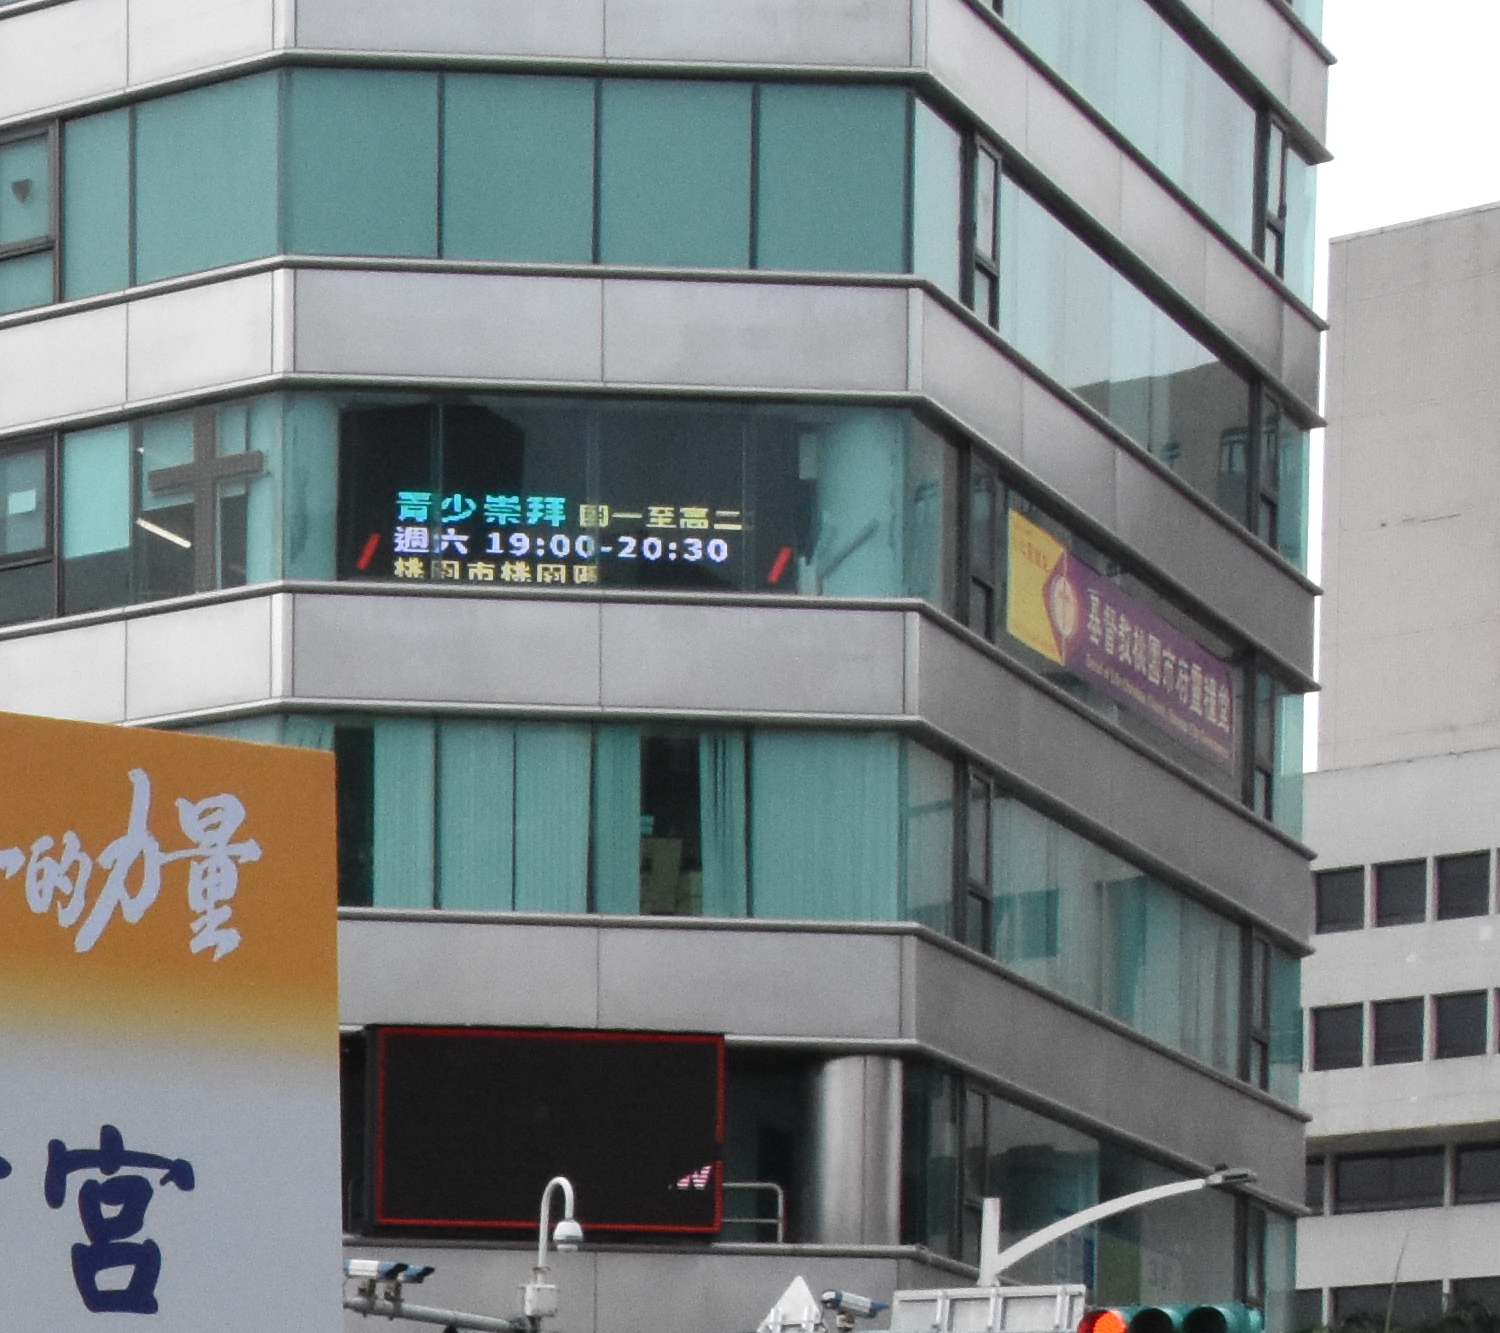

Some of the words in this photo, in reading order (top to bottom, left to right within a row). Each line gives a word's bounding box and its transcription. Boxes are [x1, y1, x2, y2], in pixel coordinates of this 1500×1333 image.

[397, 491, 567, 528] 青少崇拜
[394, 527, 469, 556] 週六
[485, 532, 730, 563] 19:00-20:30
